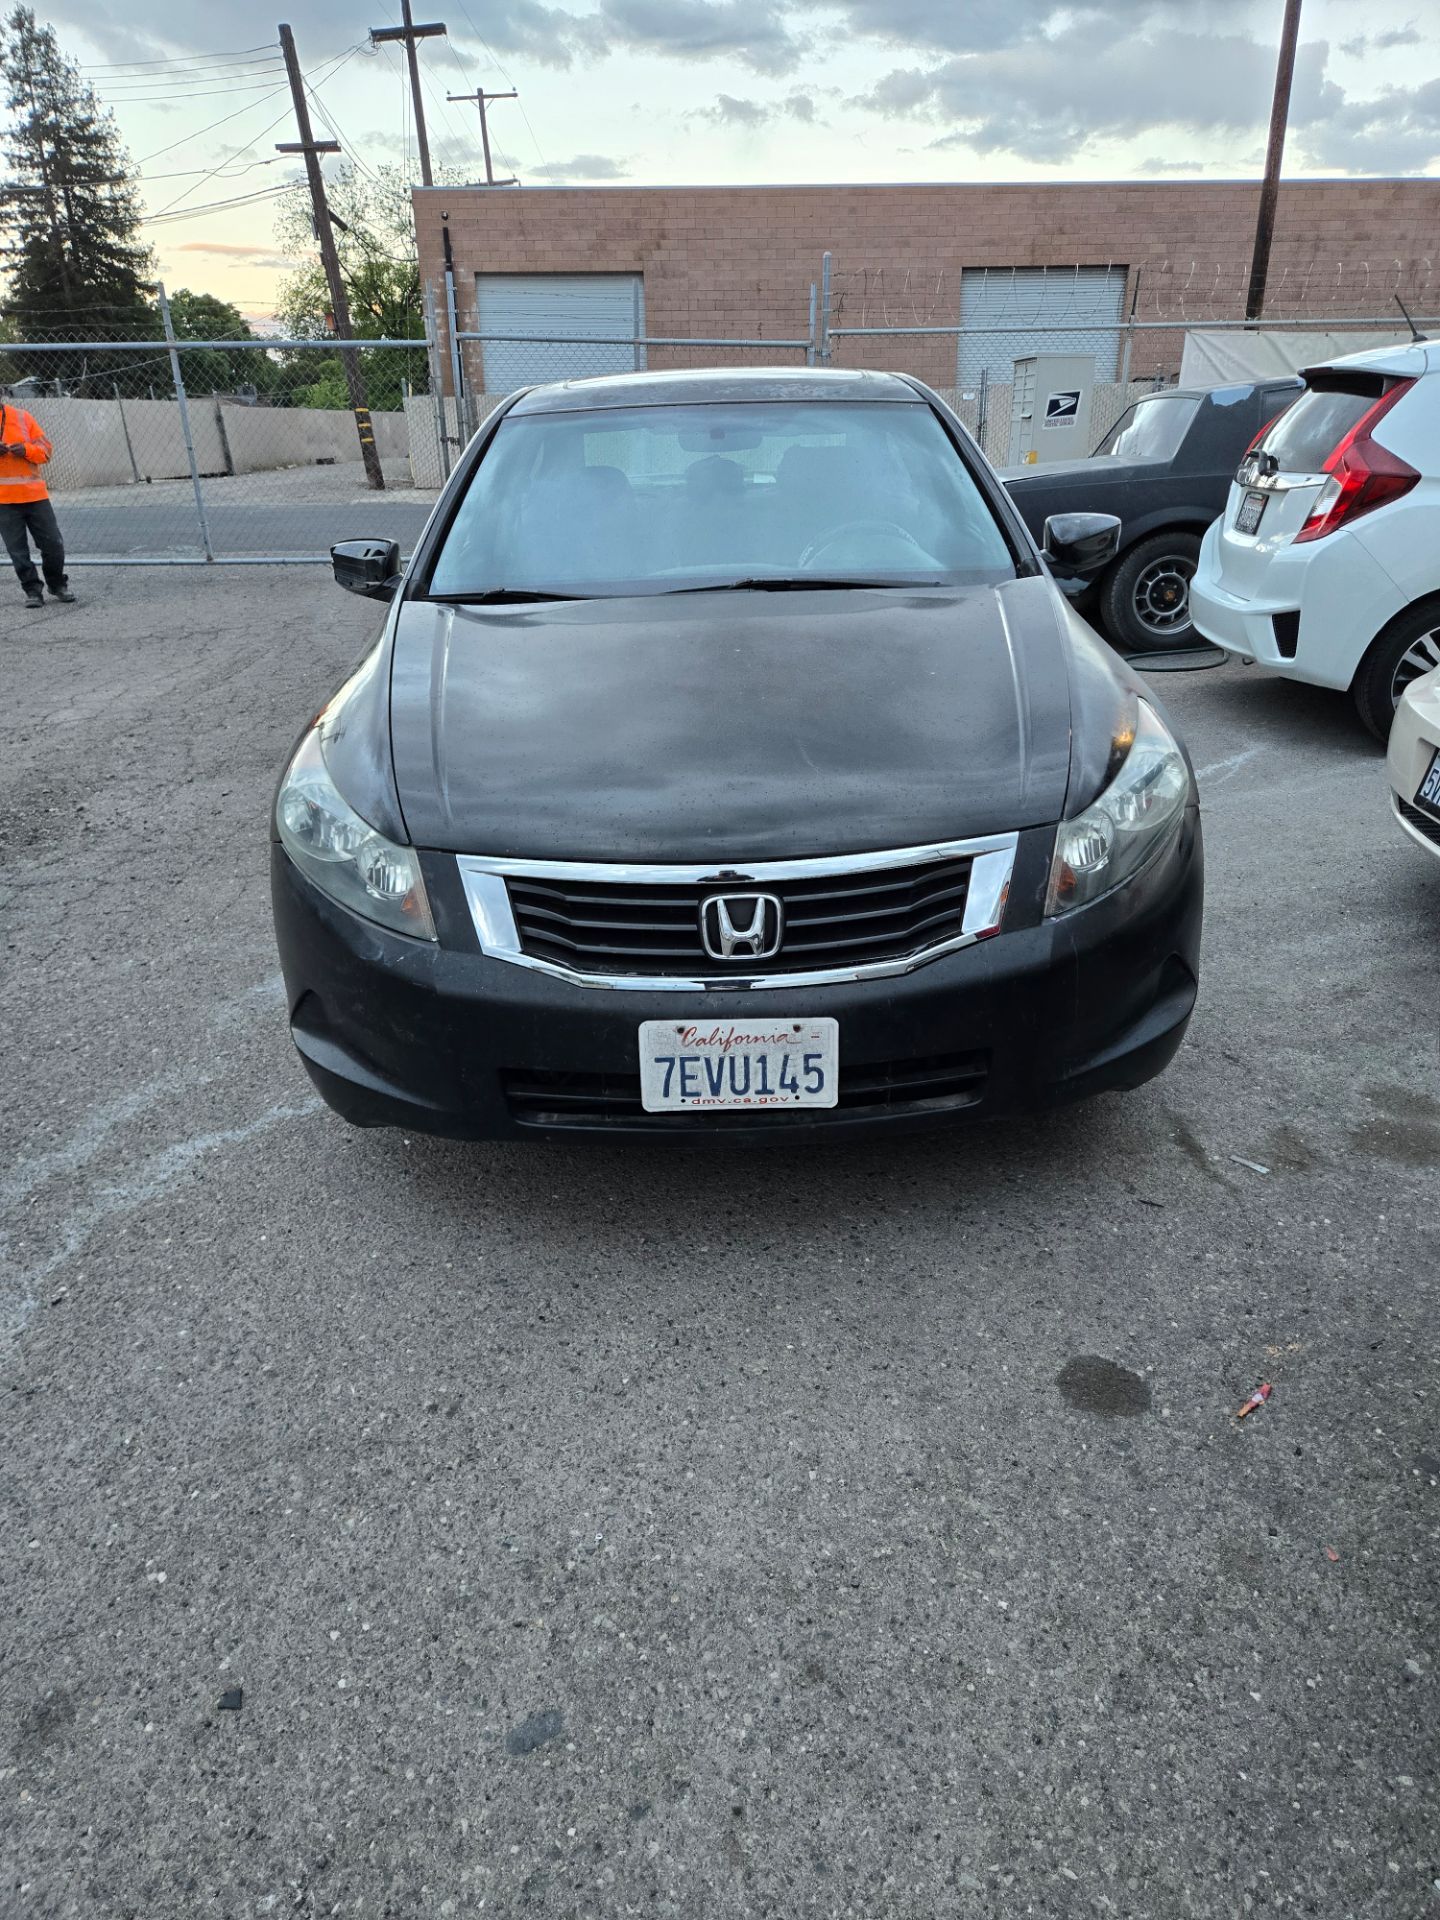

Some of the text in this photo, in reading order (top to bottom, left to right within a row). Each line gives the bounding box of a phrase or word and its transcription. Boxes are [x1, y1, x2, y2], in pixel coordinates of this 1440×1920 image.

[682, 1026, 802, 1052] California
[654, 1053, 825, 1098] 7EVU145
[691, 1096, 789, 1105] dmv.ca.gov
